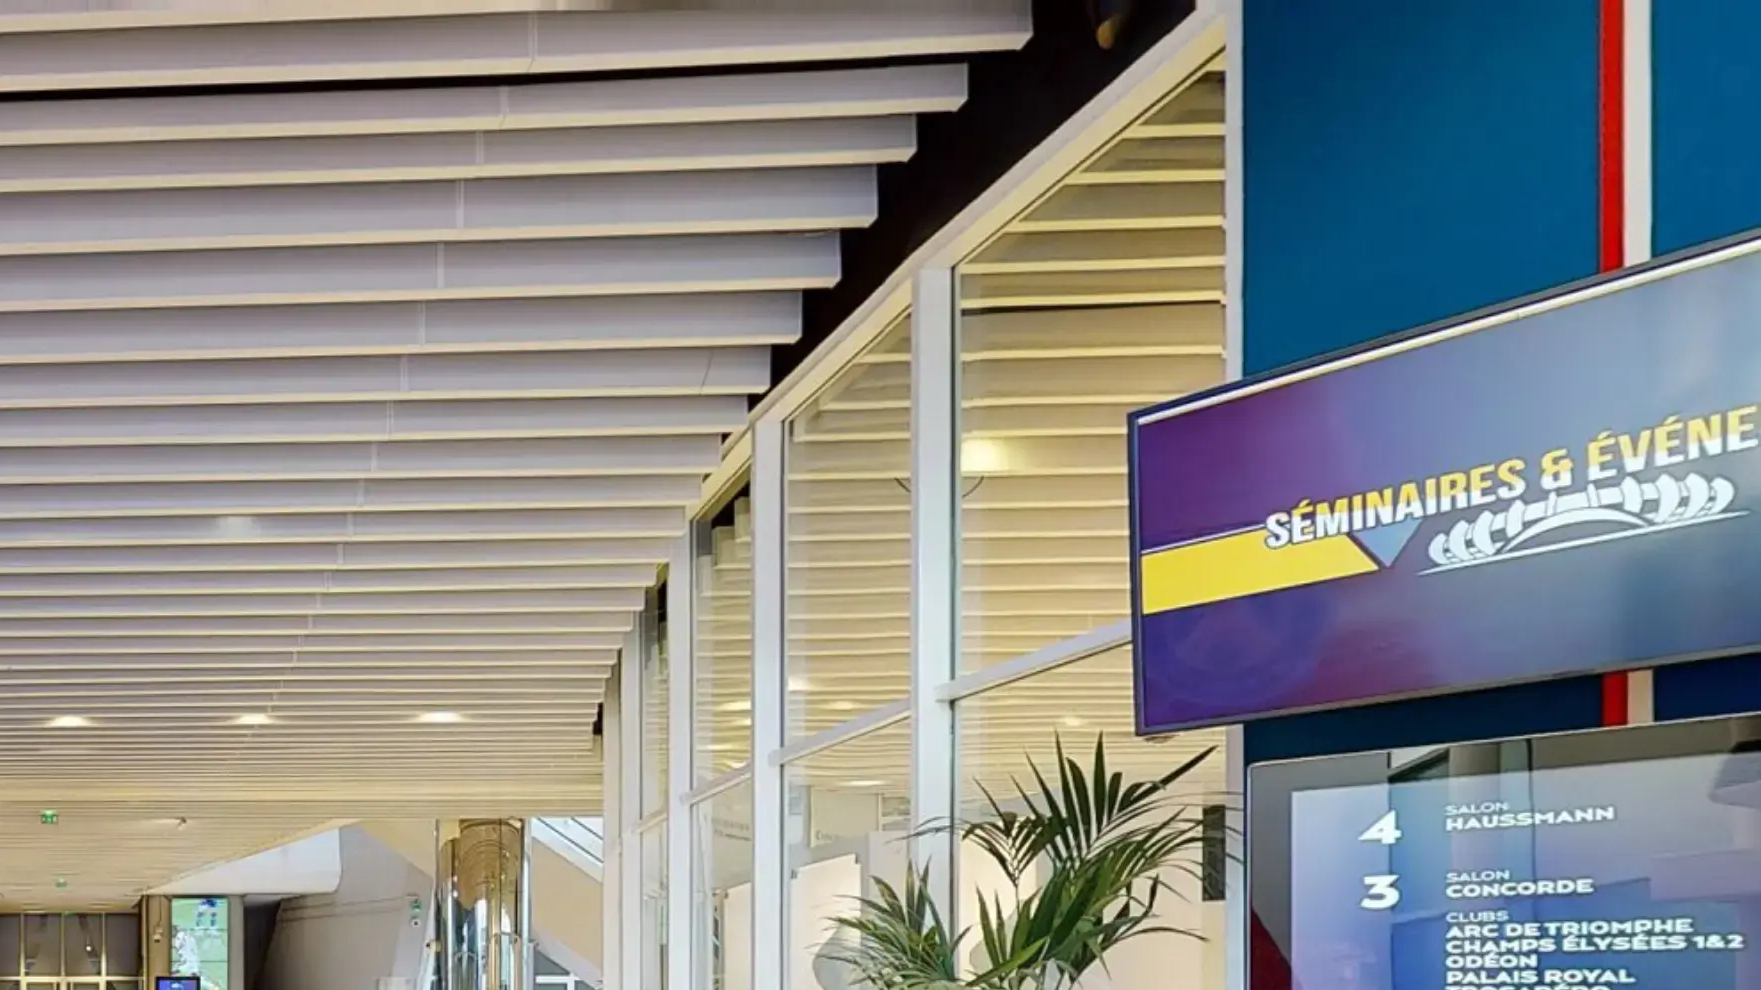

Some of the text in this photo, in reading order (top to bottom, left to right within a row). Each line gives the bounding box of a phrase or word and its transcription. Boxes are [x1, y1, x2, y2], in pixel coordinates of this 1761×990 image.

[1264, 459, 1526, 549] SÉMINAIRES
[1540, 448, 1573, 490] &
[1445, 801, 1508, 815] SALON
[1357, 809, 1402, 844] 4
[1445, 806, 1615, 831] HAUSSMANN
[1446, 870, 1510, 883] SALON
[1360, 874, 1400, 909] 3
[1446, 878, 1594, 898] CONCORDE
[1446, 910, 1509, 923] CLUBS
[1446, 918, 1694, 938] ARC DE TRIOMPHE
[1446, 934, 1746, 954] CHAMPS ÉLYSÉES 1&2
[1446, 951, 1538, 969] ODÉON
[1446, 969, 1636, 985] PALAIS ROYAL
